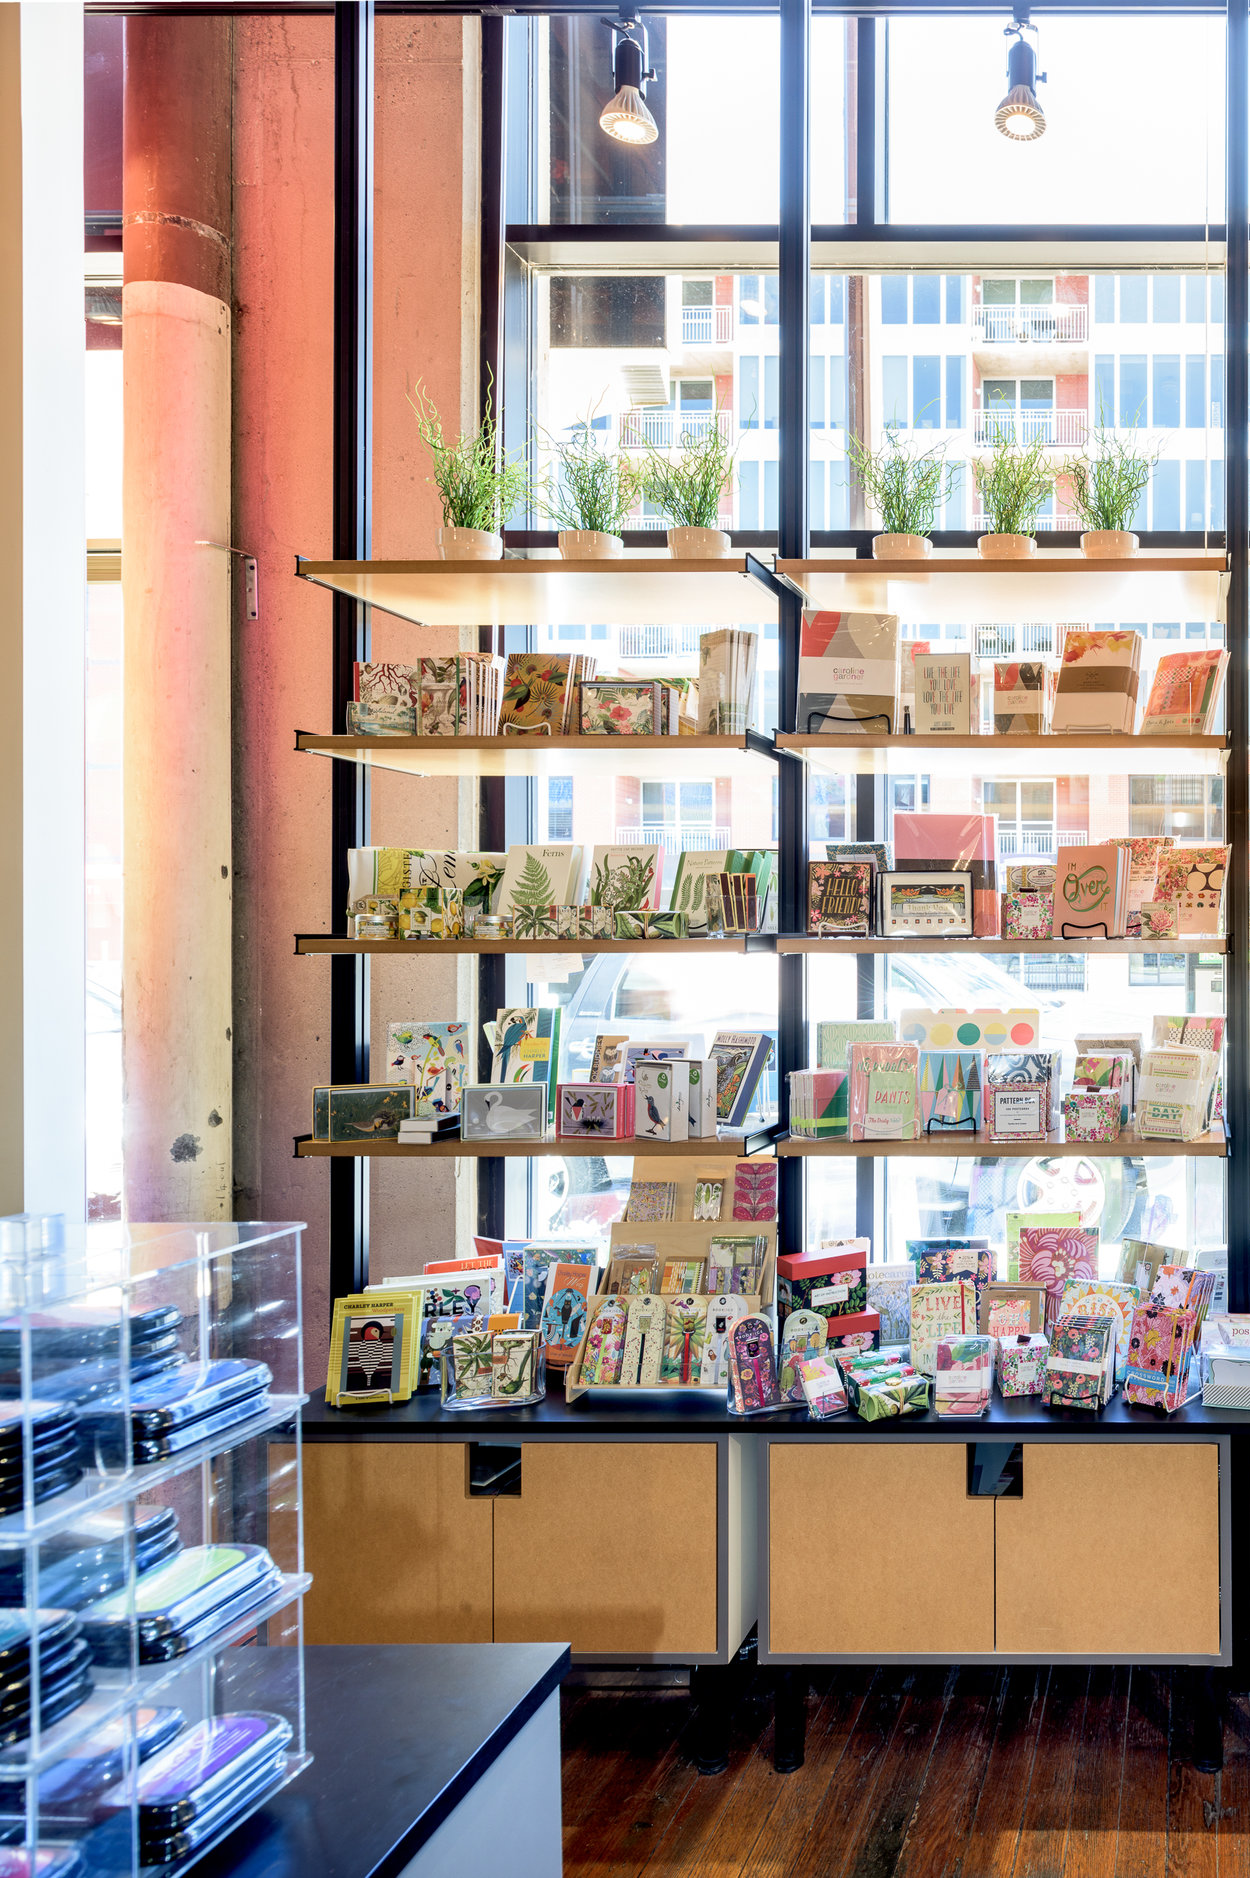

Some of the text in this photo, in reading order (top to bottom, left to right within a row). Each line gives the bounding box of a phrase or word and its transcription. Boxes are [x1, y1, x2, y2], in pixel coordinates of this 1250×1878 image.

[833, 667, 865, 675] caroline
[833, 673, 865, 681] gardner
[938, 667, 948, 678] THE
[950, 666, 961, 678] LIFE
[929, 679, 956, 691] YOU LOVE
[922, 691, 962, 703] LOVE THE LIFE
[930, 703, 954, 715] YOU LIVE
[542, 849, 565, 858] Ferns
[821, 896, 862, 914] FRIEND!
[1100, 902, 1108, 911] IT
[874, 1090, 911, 1105] PANTS
[1151, 1108, 1180, 1119] DAY
[461, 1261, 477, 1269] LET
[478, 1259, 493, 1268] THE
[425, 1301, 477, 1317] RLEY
[925, 1296, 962, 1312] LIVE
[927, 1322, 961, 1337] LIFE
[992, 1326, 1027, 1337] HAPPY
[1126, 1370, 1165, 1383] CROSSWORD
